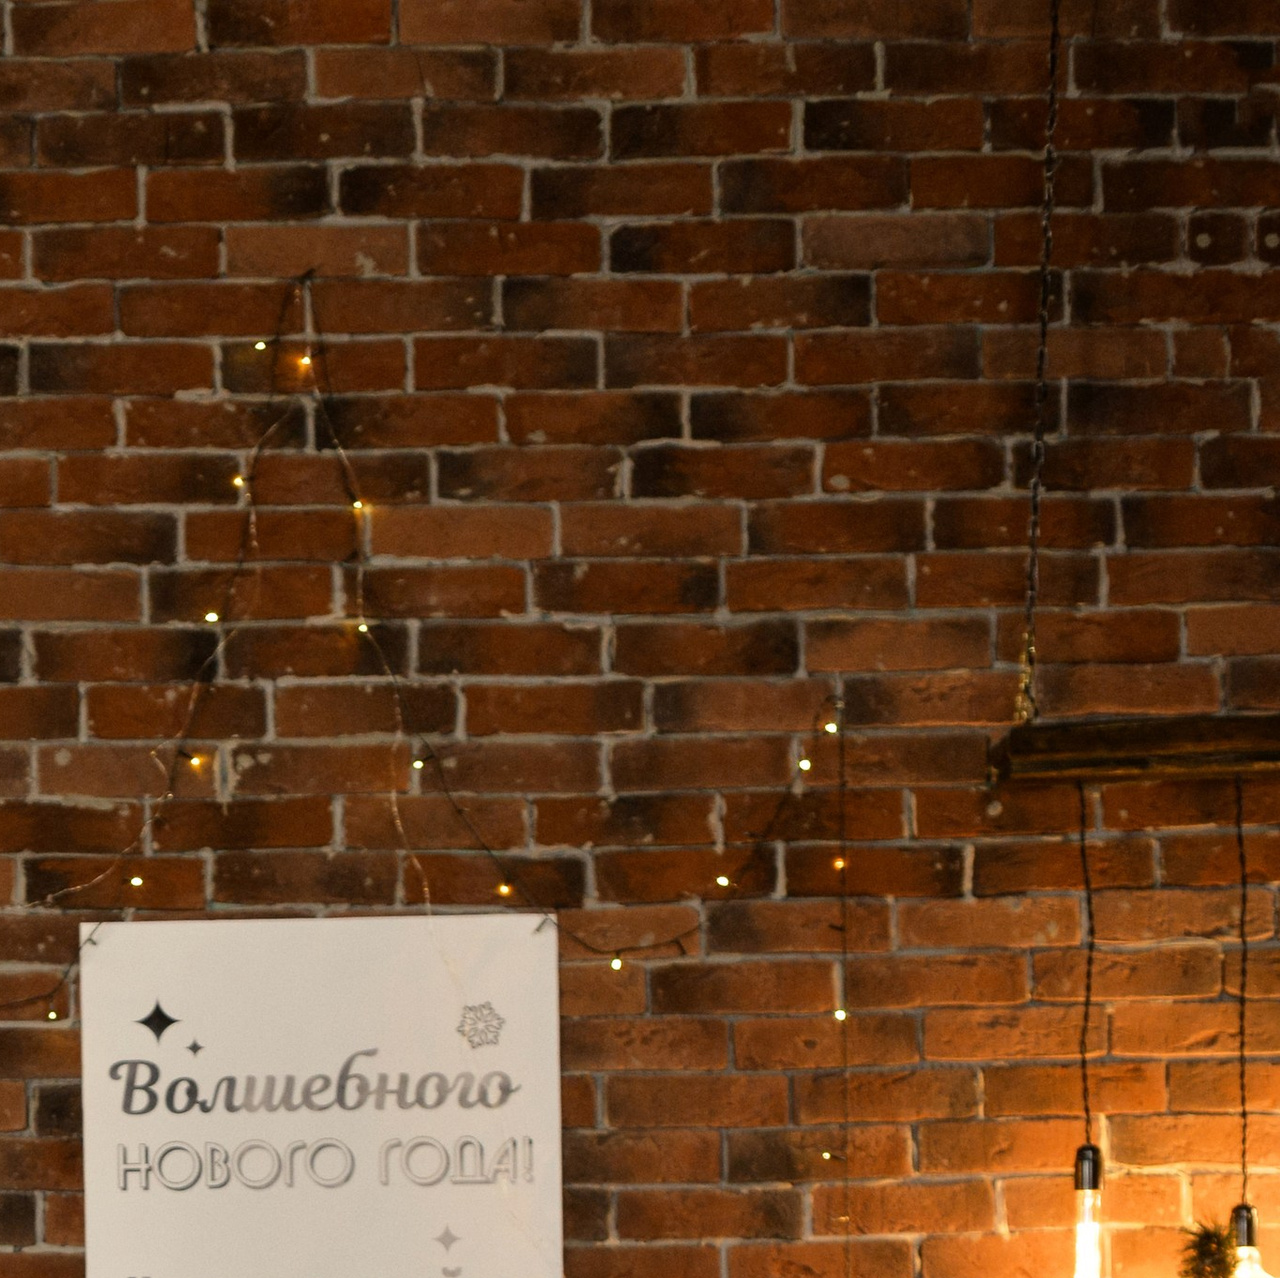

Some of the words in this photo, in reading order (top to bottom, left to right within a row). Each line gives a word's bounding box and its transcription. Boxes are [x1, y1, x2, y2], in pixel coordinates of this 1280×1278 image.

[108, 1048, 522, 1116] Волшебного
[117, 1137, 357, 1193] НОВОГО
[378, 1135, 535, 1188] ГОДА!
